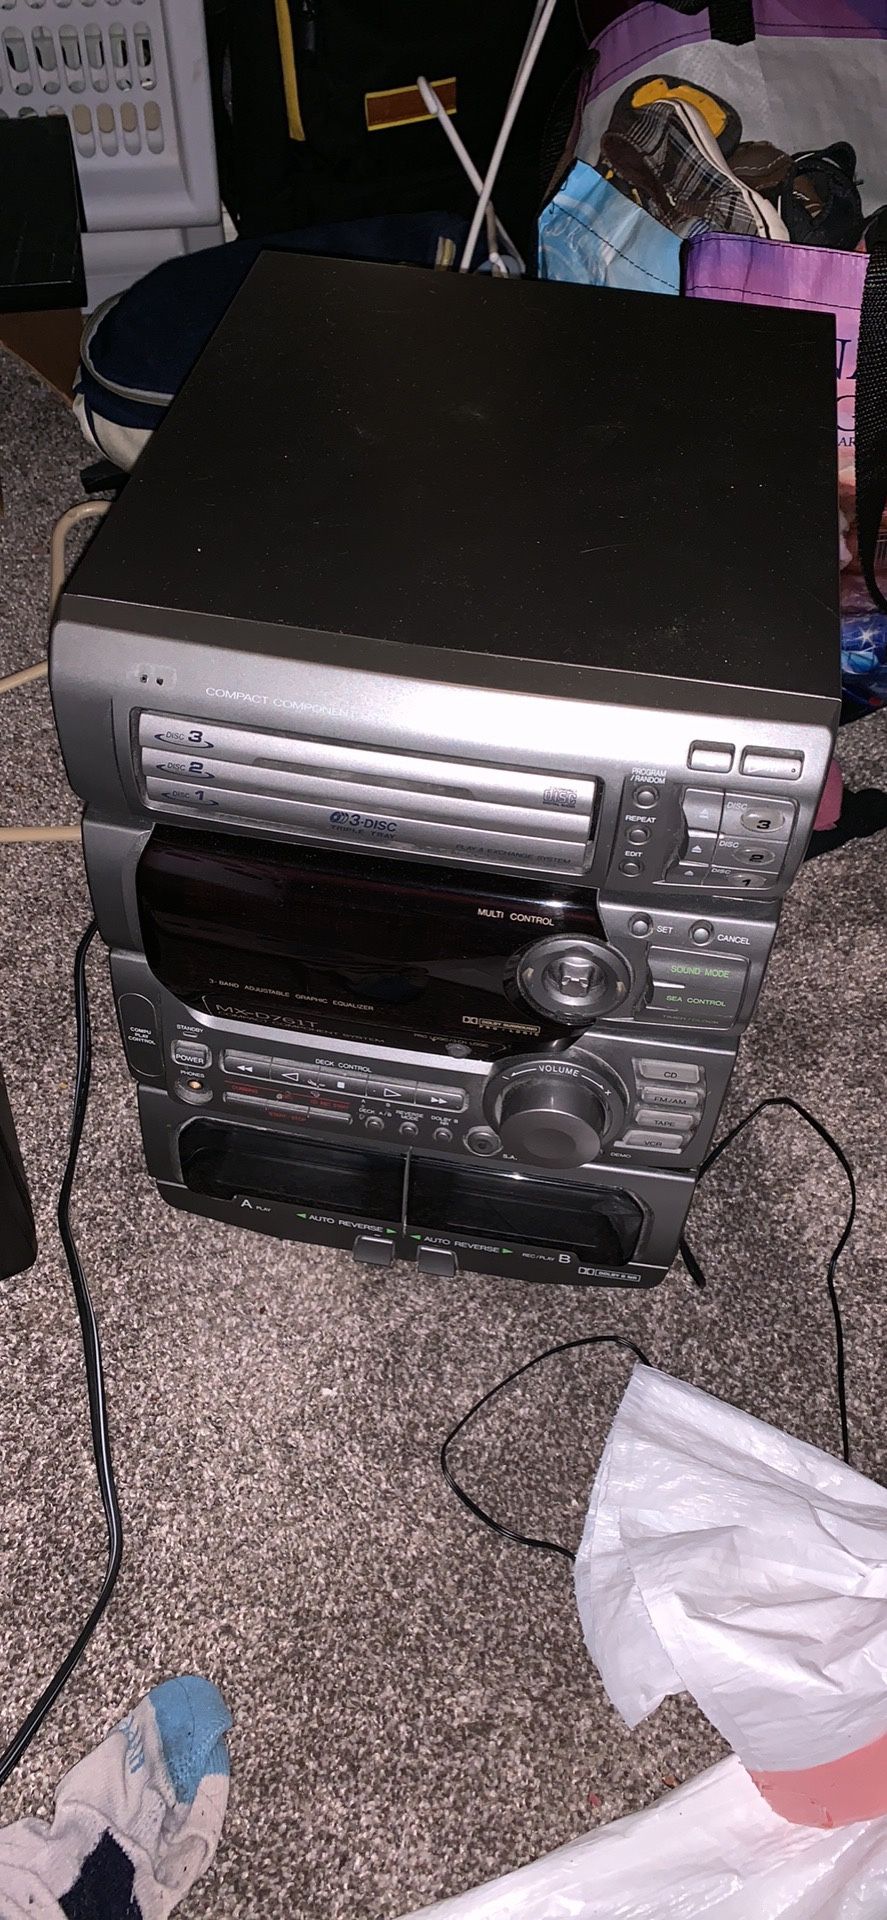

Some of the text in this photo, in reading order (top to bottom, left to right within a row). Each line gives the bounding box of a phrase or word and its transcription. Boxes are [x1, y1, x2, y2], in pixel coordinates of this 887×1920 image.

[205, 687, 270, 704] COMPACT
[272, 698, 356, 718] COMPONENT
[166, 730, 203, 742] DISC 3
[167, 762, 204, 774] DISC 2
[631, 767, 667, 777] PROGRAM
[172, 790, 204, 801] DISC 1
[625, 815, 657, 823] REPEAT
[726, 802, 771, 829] DISC 3
[350, 814, 397, 832] 3-DISC
[331, 825, 397, 840] TRIPLE TRAY
[624, 850, 643, 858] EDIT
[719, 840, 764, 862] DISC 2
[742, 879, 751, 887] 1
[477, 907, 555, 927] MULTI CONTROL
[656, 925, 673, 934] SET
[717, 934, 751, 945] CANCEL
[671, 965, 731, 978] SOUND MODE
[244, 985, 290, 998] ADJUSTABLE
[295, 994, 328, 1004] GRAPHIC
[332, 1000, 374, 1011] EQUALIZER
[665, 995, 726, 1007] SEA CONTROL
[129, 1026, 151, 1035] COMPU
[176, 1024, 203, 1033] STANDBY
[128, 1035, 156, 1045] CONTROL
[175, 1053, 204, 1064] POWER
[315, 1058, 372, 1073] DECK CONTROL
[538, 1064, 580, 1077] VOLUME
[180, 1070, 205, 1078] PHONES
[663, 1071, 678, 1079] CD
[654, 1096, 687, 1105] FM/AM
[395, 1110, 424, 1119] REVERSE
[430, 1115, 452, 1123] DOLBY
[240, 1199, 253, 1209] A
[308, 1214, 384, 1233] AUTO REVERSE
[424, 1235, 500, 1254] AUTO REVERSE
[522, 1252, 571, 1264] REC/PLAY B
